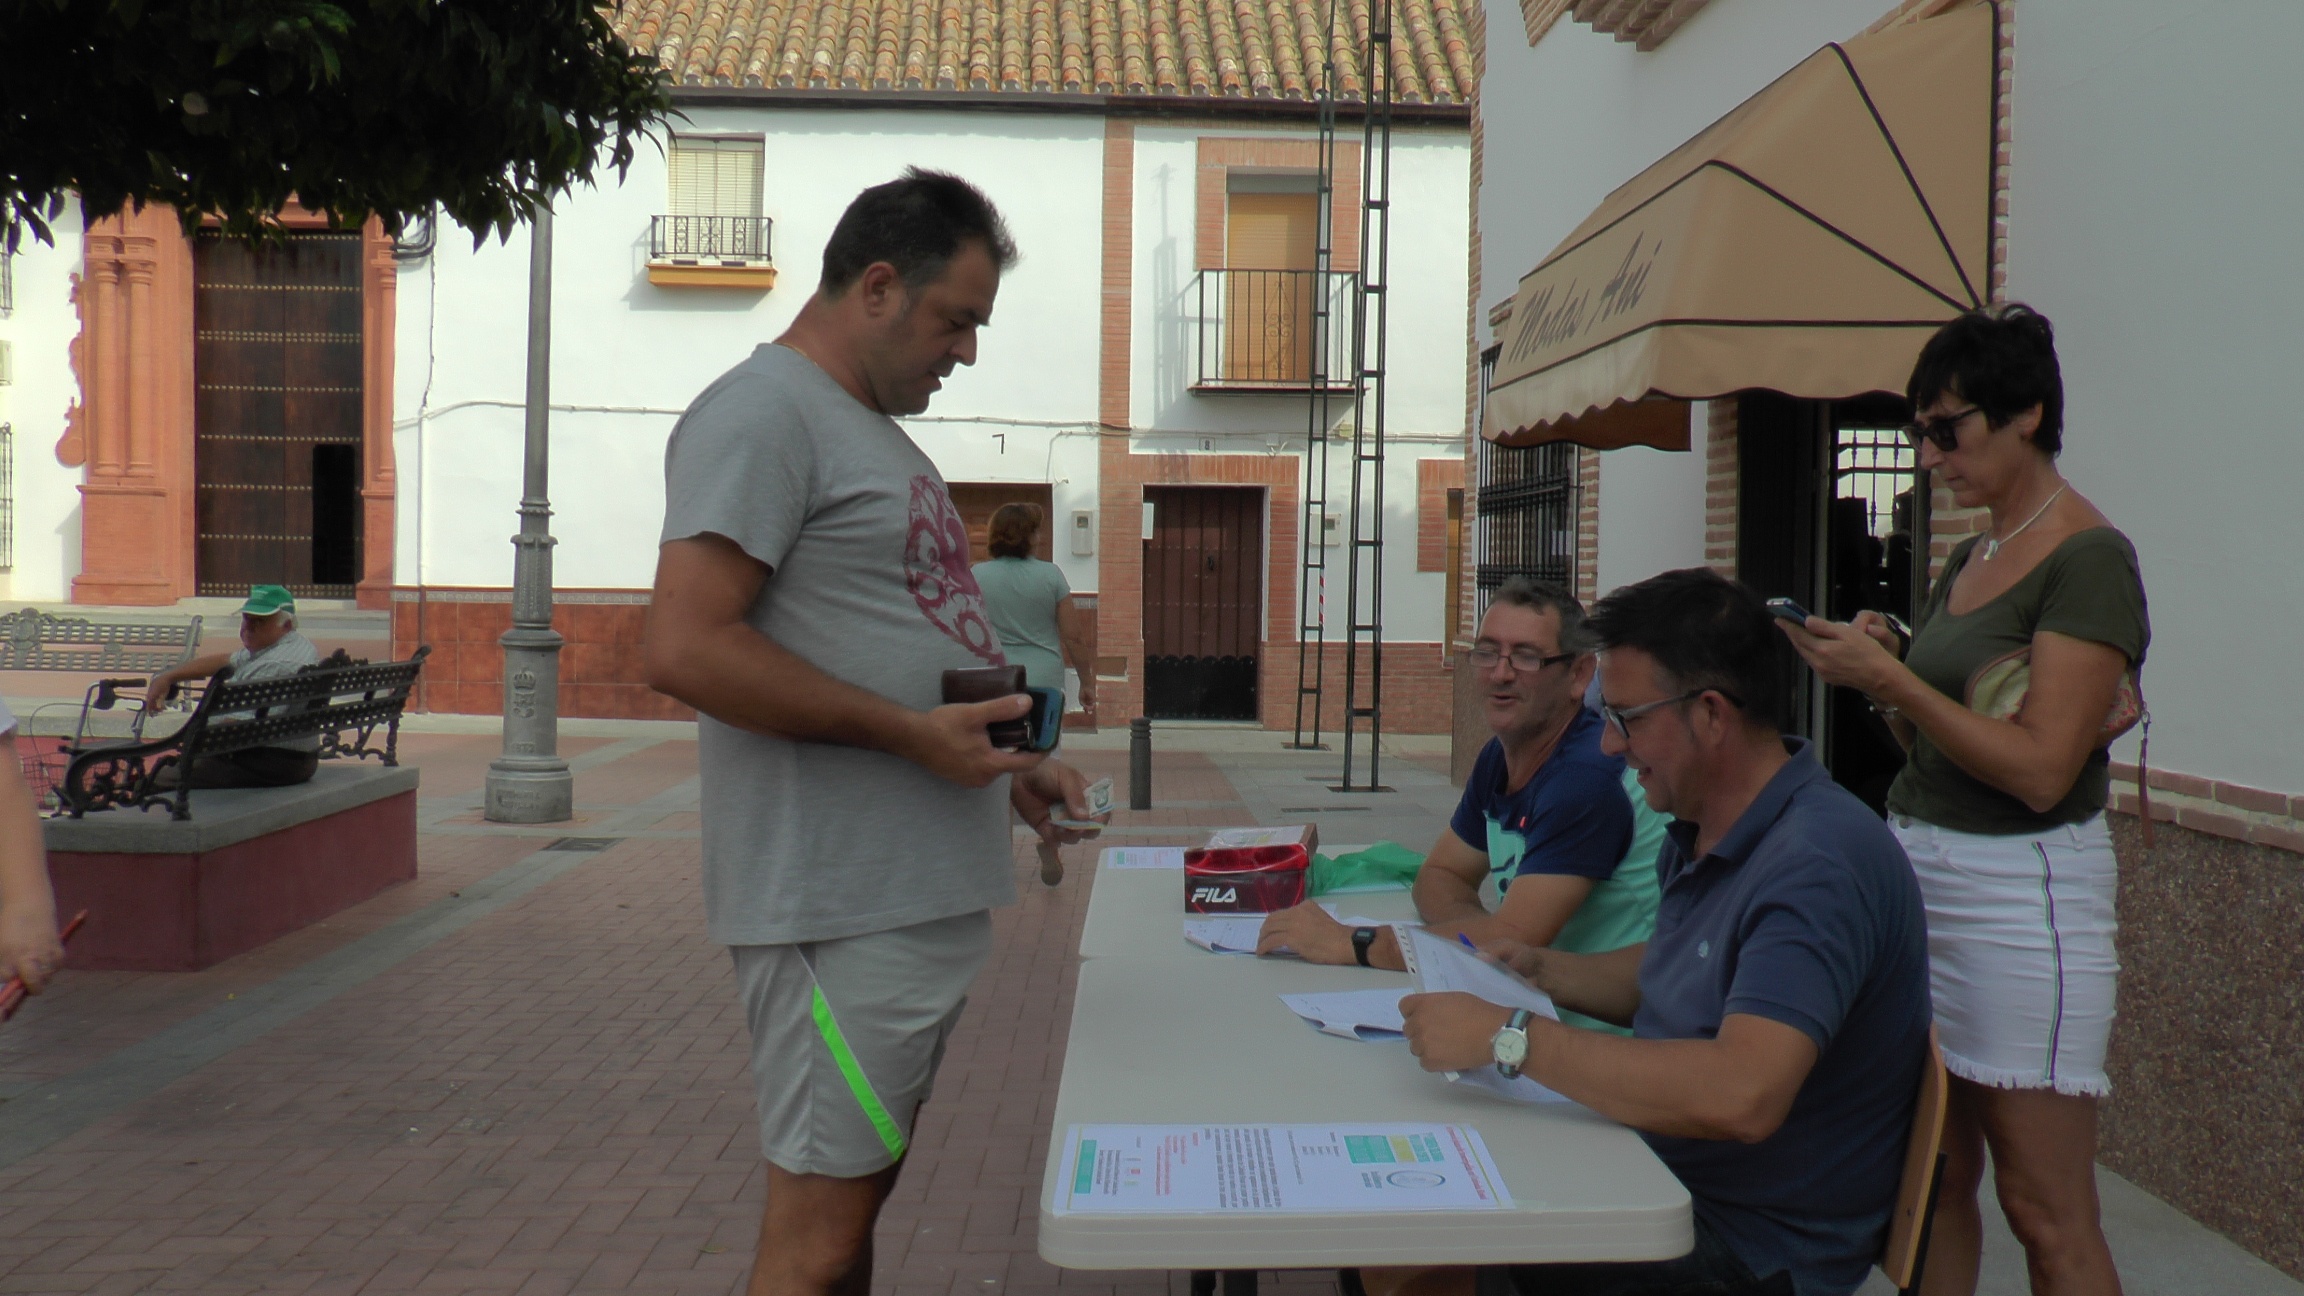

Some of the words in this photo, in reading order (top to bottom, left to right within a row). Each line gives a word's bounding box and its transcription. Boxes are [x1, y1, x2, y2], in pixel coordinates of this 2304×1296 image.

[1508, 277, 1590, 363] Modas
[1584, 231, 1662, 336] Ani
[992, 433, 1004, 454] 7
[1191, 887, 1237, 903] FILA
